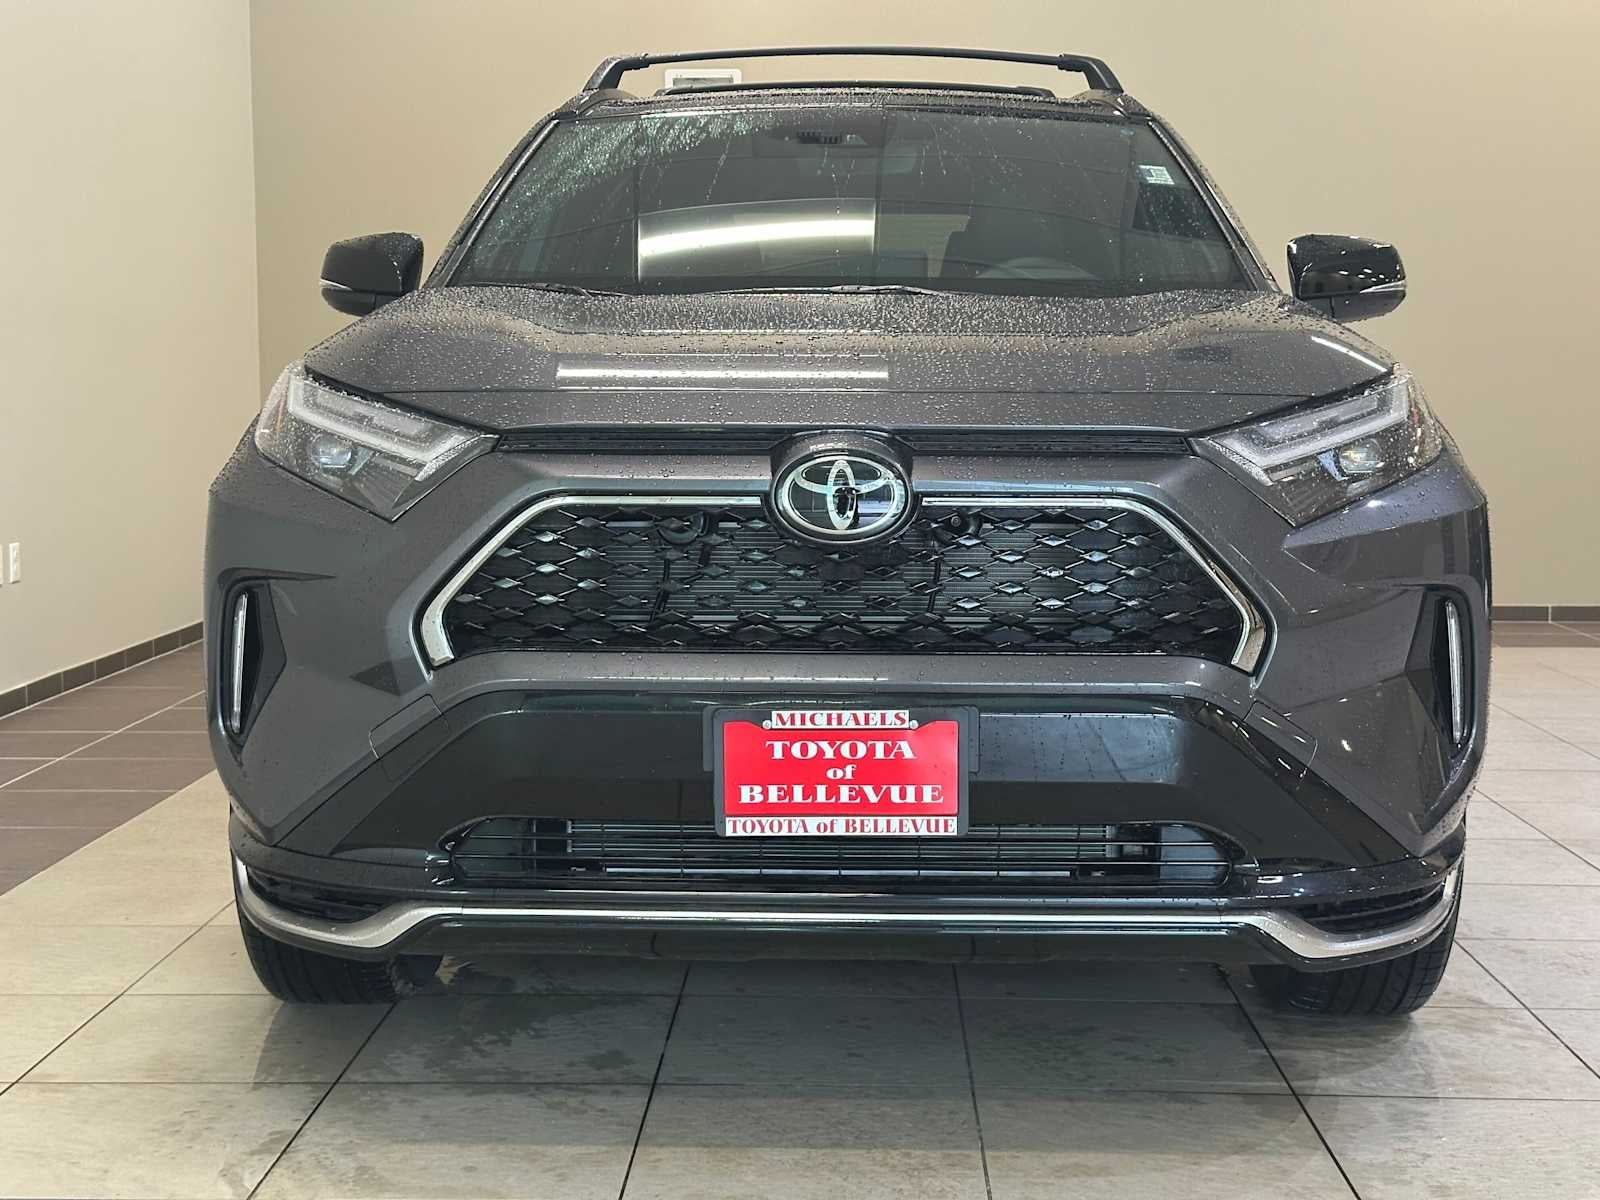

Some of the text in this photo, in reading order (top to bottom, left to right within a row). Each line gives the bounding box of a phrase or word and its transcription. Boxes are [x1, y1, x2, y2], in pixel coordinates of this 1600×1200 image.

[775, 712, 908, 727] MICHAELS
[765, 740, 917, 760] TOYOTA
[826, 764, 857, 780] of
[738, 784, 944, 804] BELLEVUE
[727, 818, 956, 834] TOYOTA of BELLEVUE
